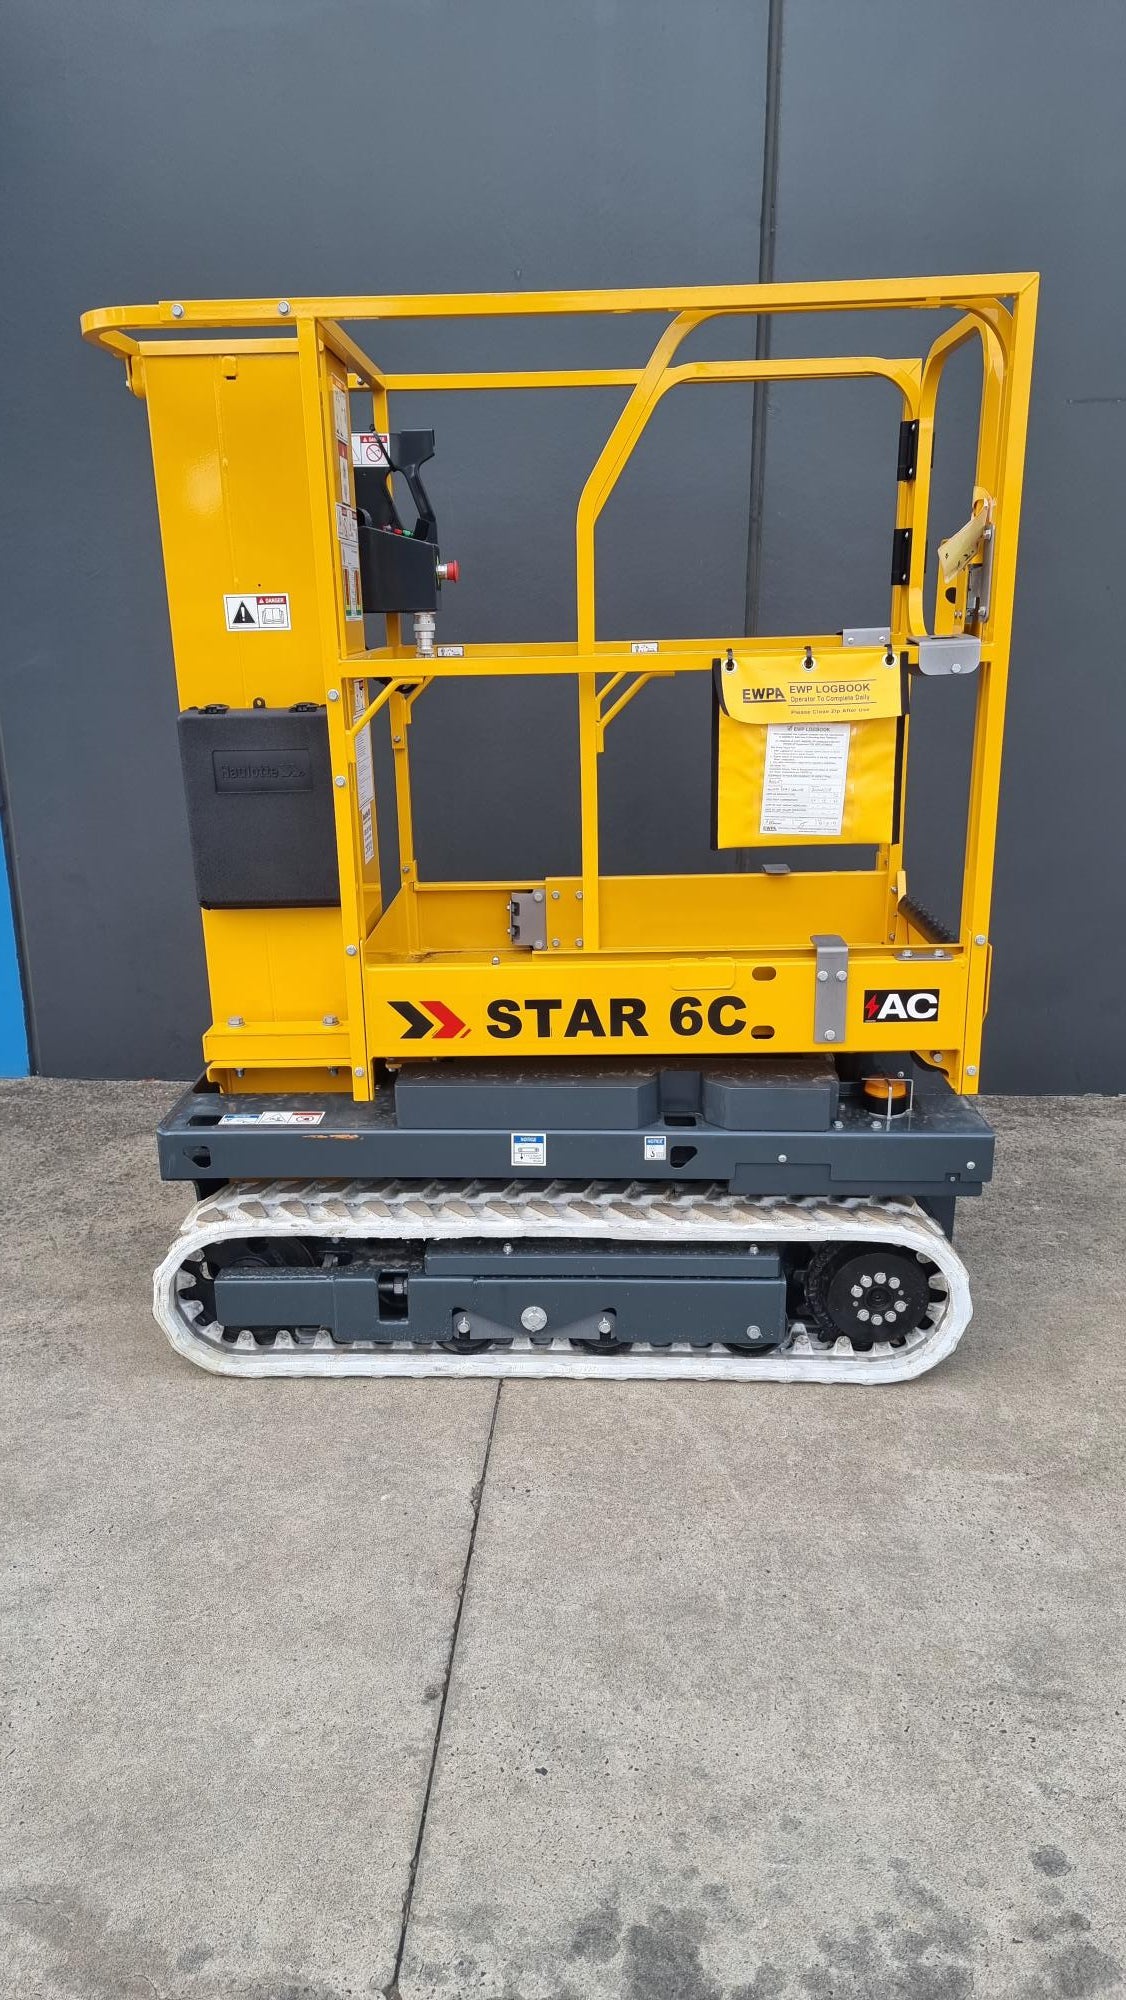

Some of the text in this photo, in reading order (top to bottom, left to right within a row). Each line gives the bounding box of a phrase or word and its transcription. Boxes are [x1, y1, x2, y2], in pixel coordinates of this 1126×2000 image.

[742, 687, 786, 700] EWPA
[790, 683, 870, 694] EWP LOGBOOK
[855, 694, 870, 702] Daily
[877, 993, 938, 1019] AC
[487, 995, 747, 1039] STAR 6C
